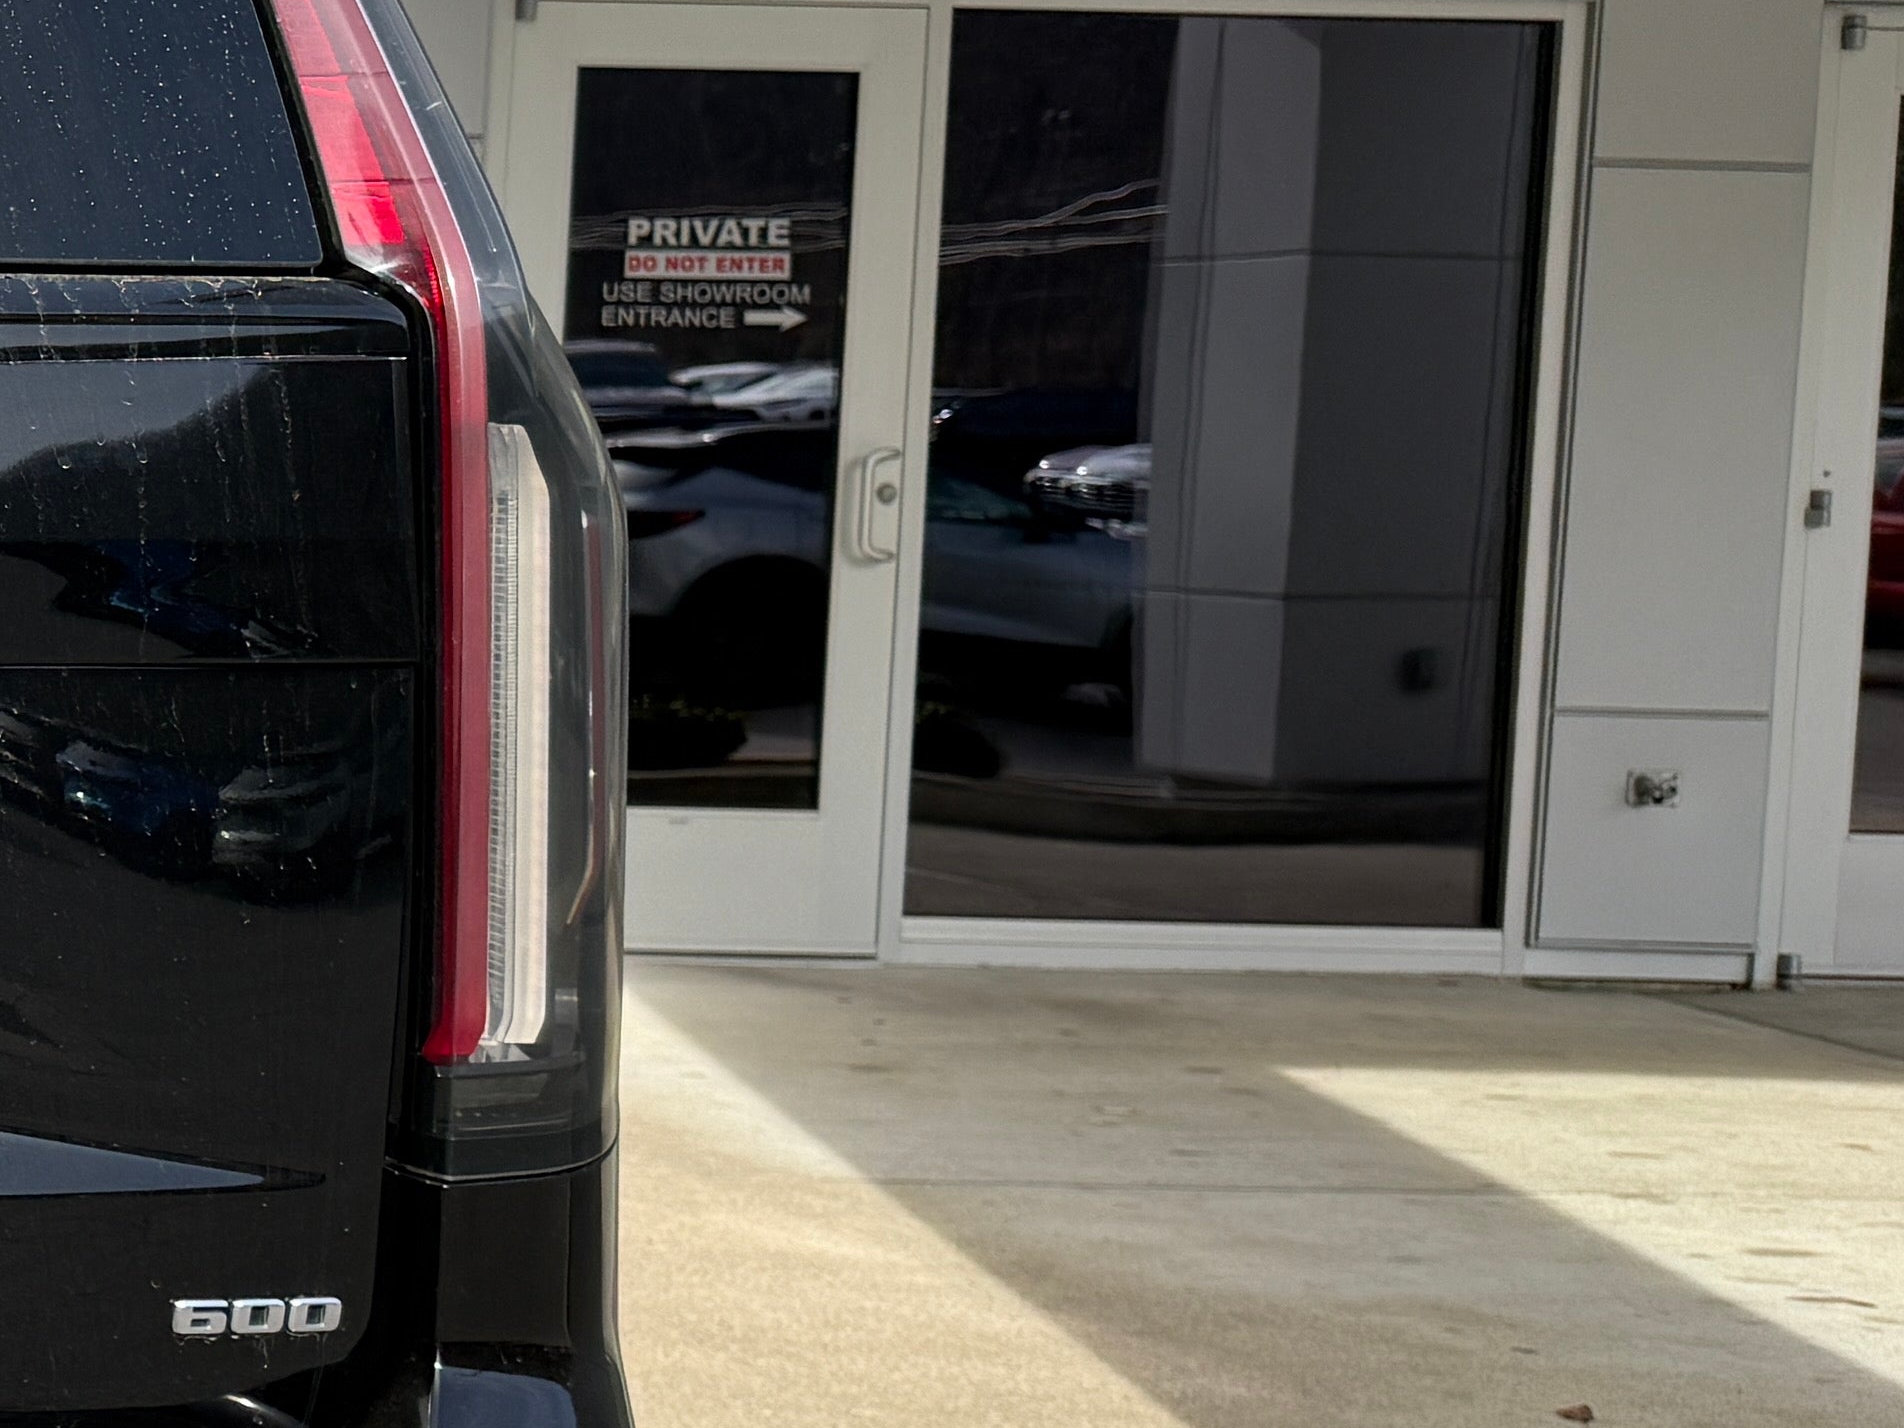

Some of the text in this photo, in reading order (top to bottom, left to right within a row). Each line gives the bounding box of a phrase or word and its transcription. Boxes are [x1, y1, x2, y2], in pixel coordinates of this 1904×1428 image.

[627, 217, 791, 247] PRIVATE
[628, 256, 785, 273] DO NOT ENTER
[602, 281, 811, 305] USE SHOWROOM
[601, 305, 735, 329] ENTRANCE
[172, 1297, 343, 1335] 600
